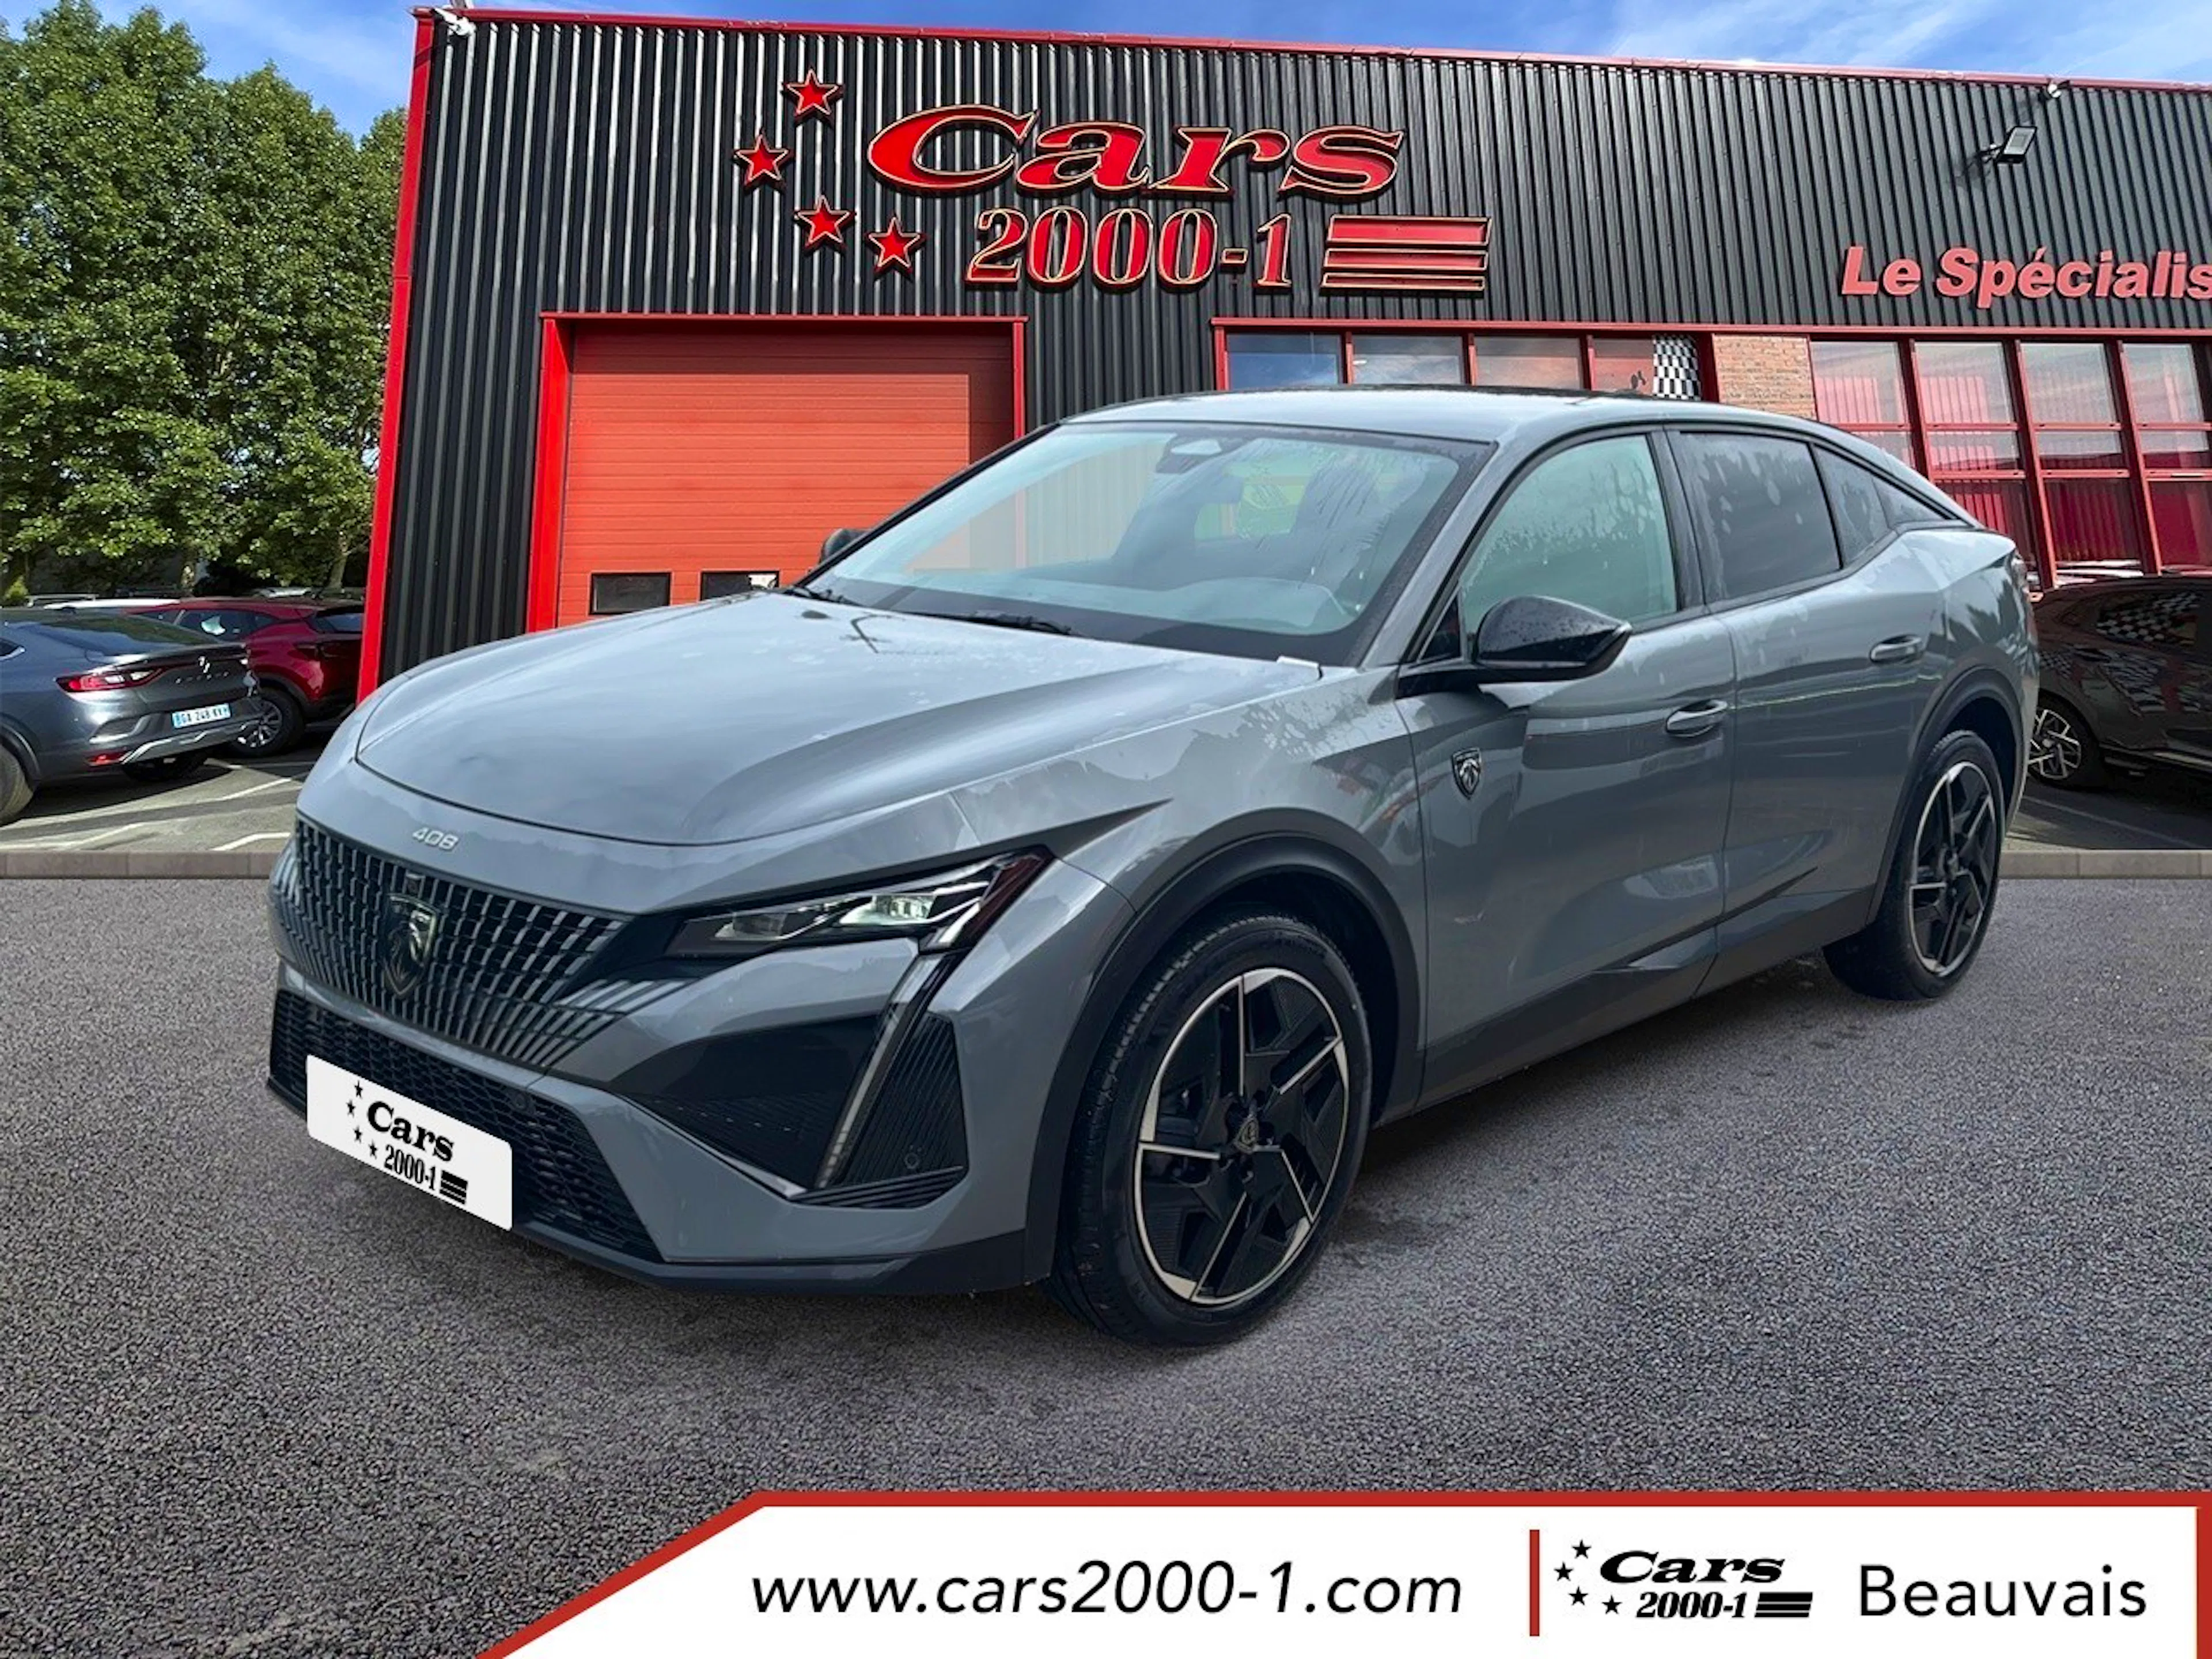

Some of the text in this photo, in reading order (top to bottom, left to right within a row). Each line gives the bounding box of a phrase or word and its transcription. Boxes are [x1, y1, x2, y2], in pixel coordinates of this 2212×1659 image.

[868, 105, 1404, 197] Cars
[965, 207, 1293, 291] 2000-1
[1842, 245, 1922, 297] Le
[412, 827, 459, 850] 408
[368, 1101, 454, 1162] Cars
